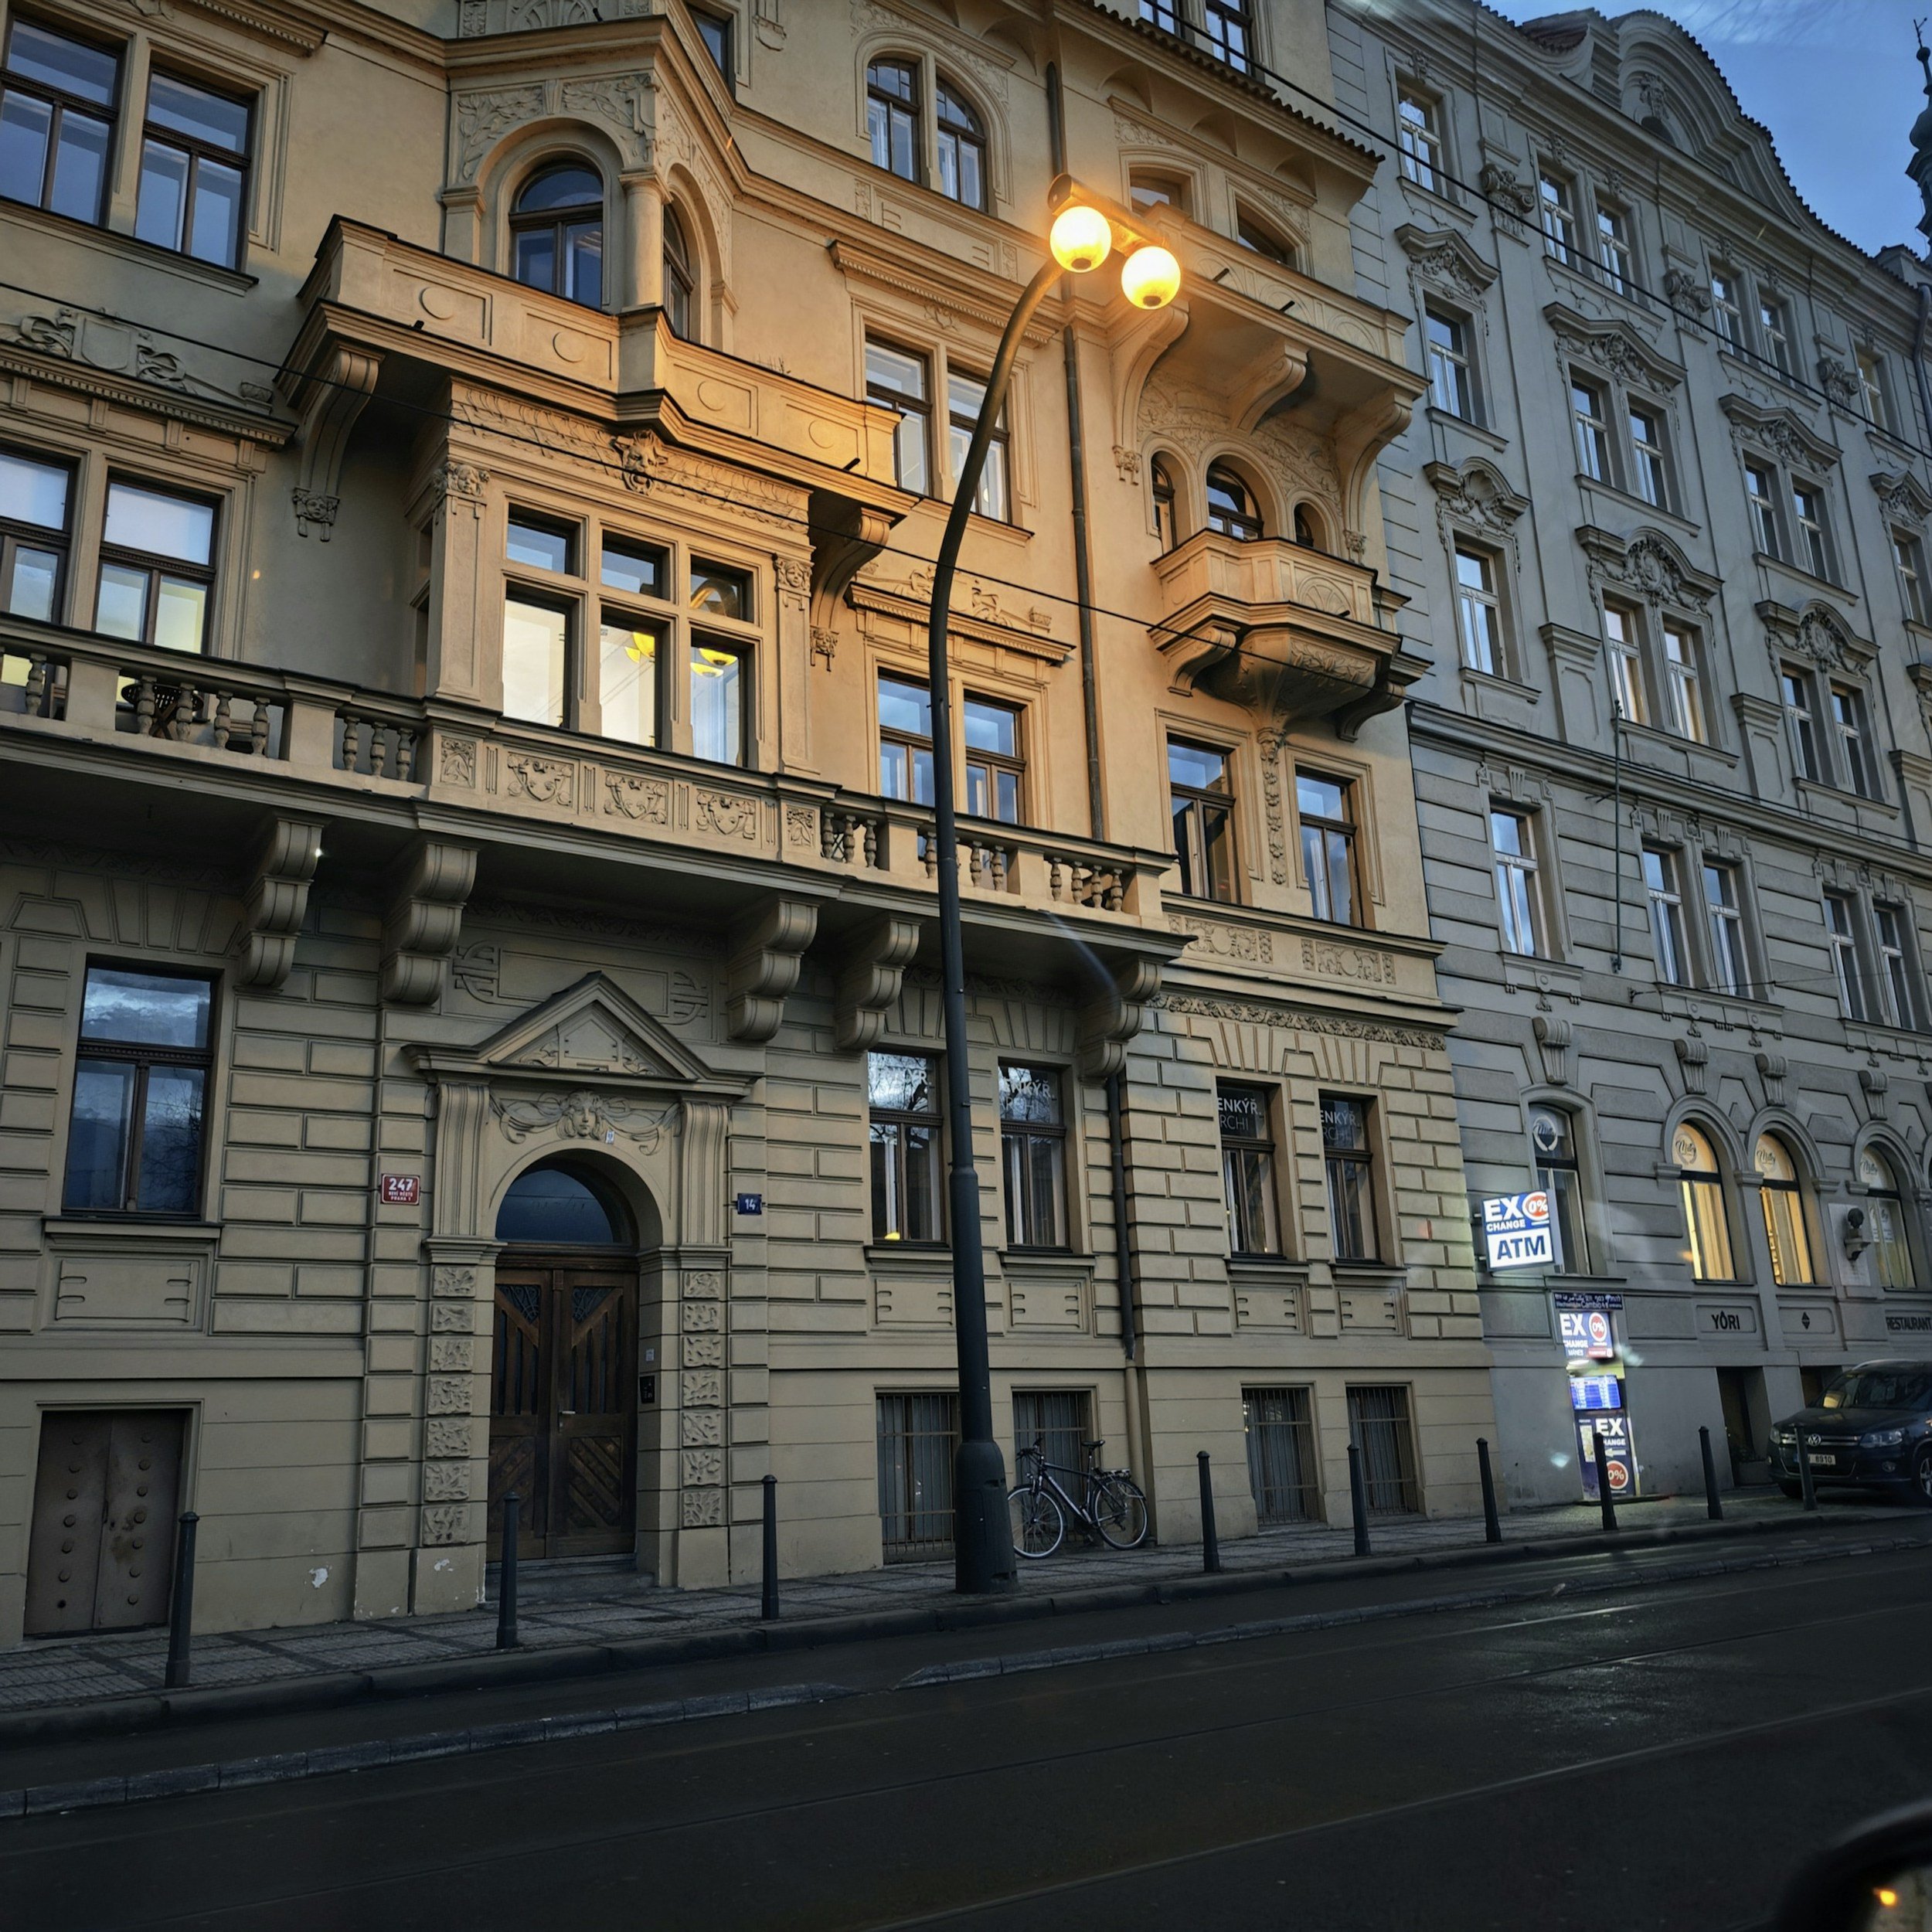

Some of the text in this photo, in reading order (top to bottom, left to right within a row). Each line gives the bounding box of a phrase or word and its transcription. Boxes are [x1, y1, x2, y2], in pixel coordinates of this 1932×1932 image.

[389, 1178, 413, 1191] 247
[745, 1199, 756, 1210] 14
[1483, 1196, 1549, 1223] EX 0%
[1486, 1219, 1526, 1233] CHANGE
[1497, 1235, 1546, 1260] ATM
[1560, 1314, 1587, 1336] EX
[1595, 1417, 1624, 1437] EX
